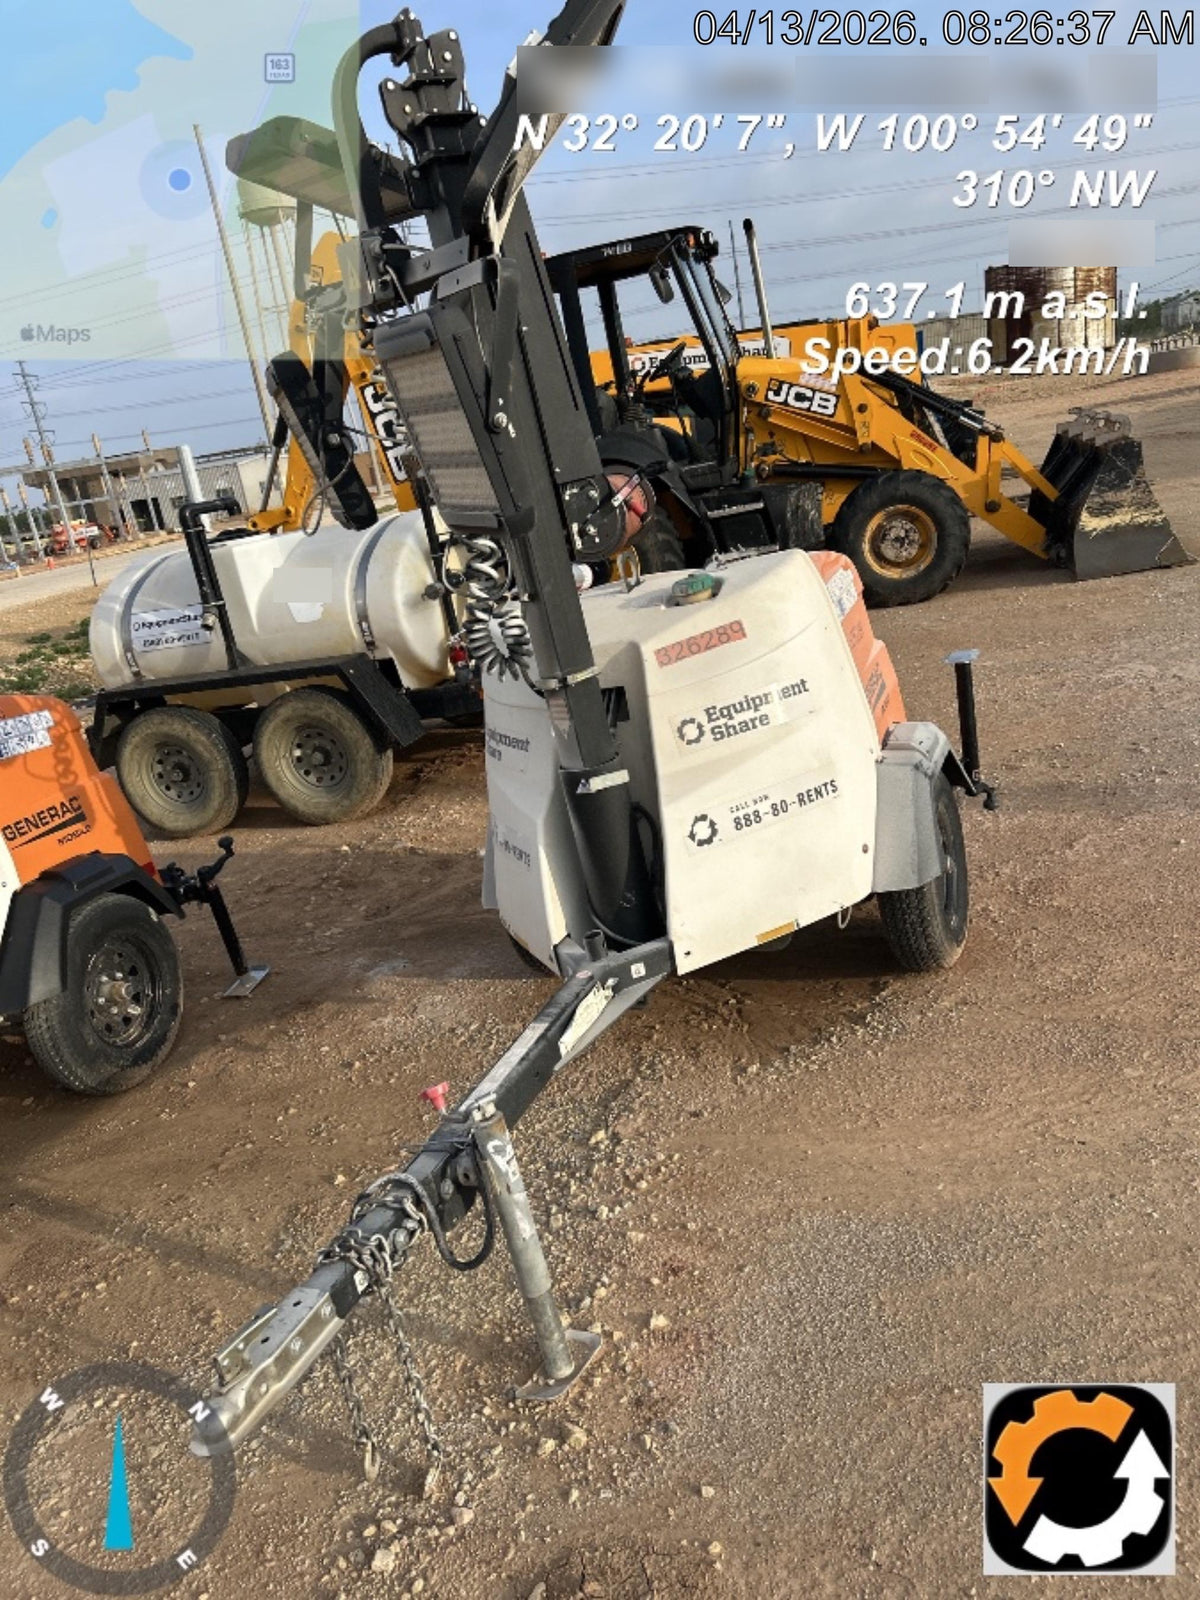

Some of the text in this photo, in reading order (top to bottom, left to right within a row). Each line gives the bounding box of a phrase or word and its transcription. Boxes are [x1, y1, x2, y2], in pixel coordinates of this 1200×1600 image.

[767, 382, 838, 416] JCB
[656, 620, 747, 667] 326289
[710, 713, 771, 743] Share
[2, 796, 83, 842] GENERAC
